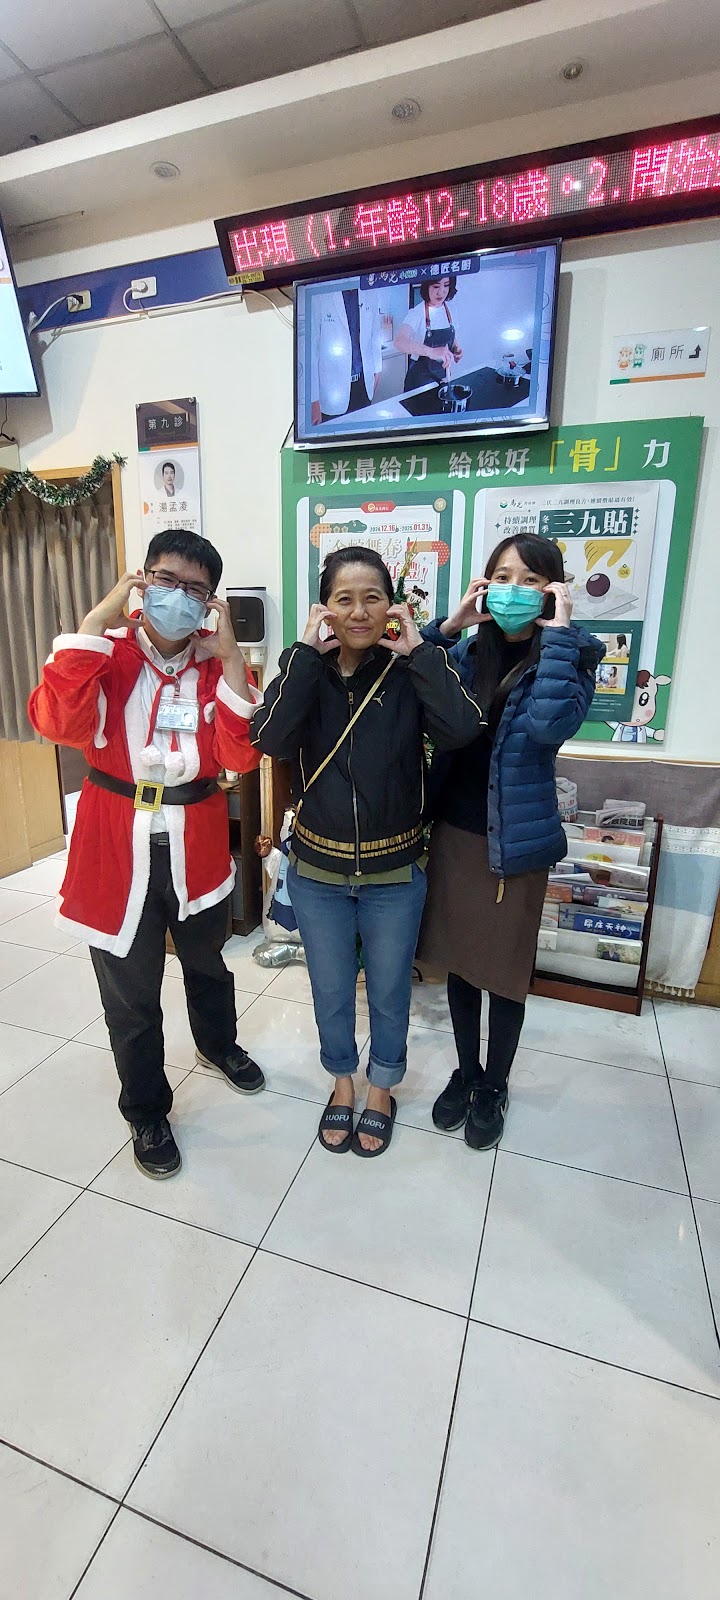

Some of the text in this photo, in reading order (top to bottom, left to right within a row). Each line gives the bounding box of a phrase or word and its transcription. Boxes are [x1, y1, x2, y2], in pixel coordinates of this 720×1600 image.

[233, 135, 720, 271] 出現（1.年齡12-18歲。2.開始
[651, 344, 686, 362] 廁所
[148, 416, 184, 431] 第九診
[306, 454, 429, 488] 馬光最給力
[551, 510, 629, 537] 三九貼
